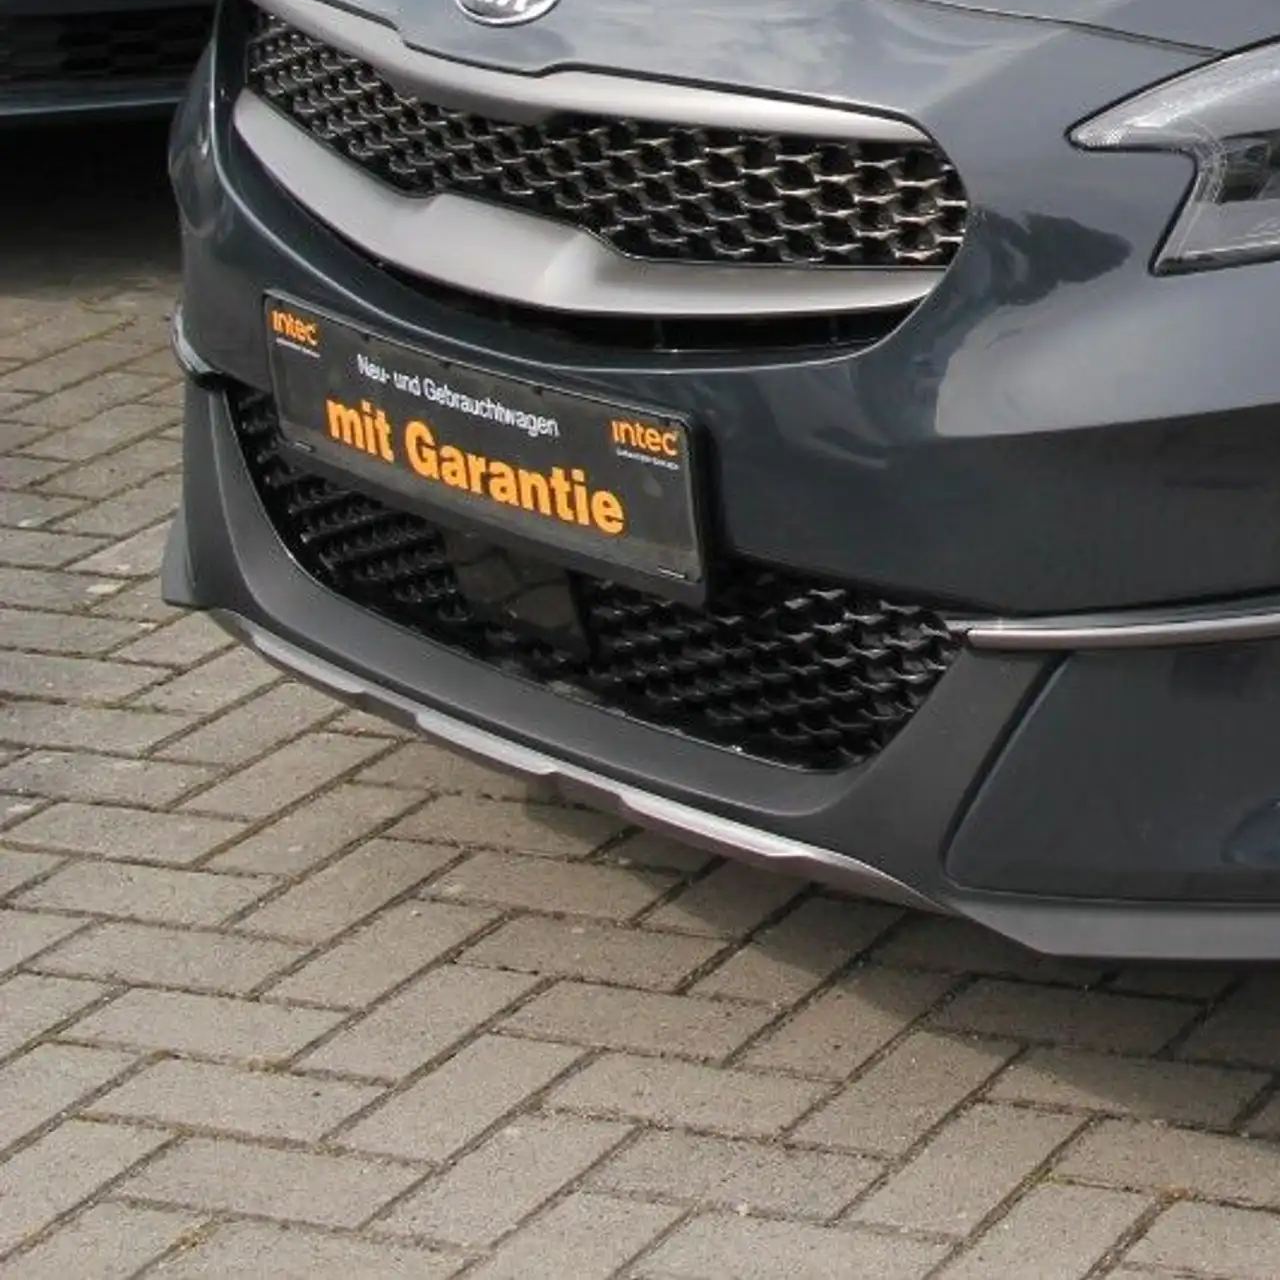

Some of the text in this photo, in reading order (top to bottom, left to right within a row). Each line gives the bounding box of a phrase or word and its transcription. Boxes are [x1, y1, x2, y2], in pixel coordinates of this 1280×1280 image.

[356, 353, 561, 437] Neu- und Gebrauchtwagen
[326, 398, 627, 537] mit Garantie
